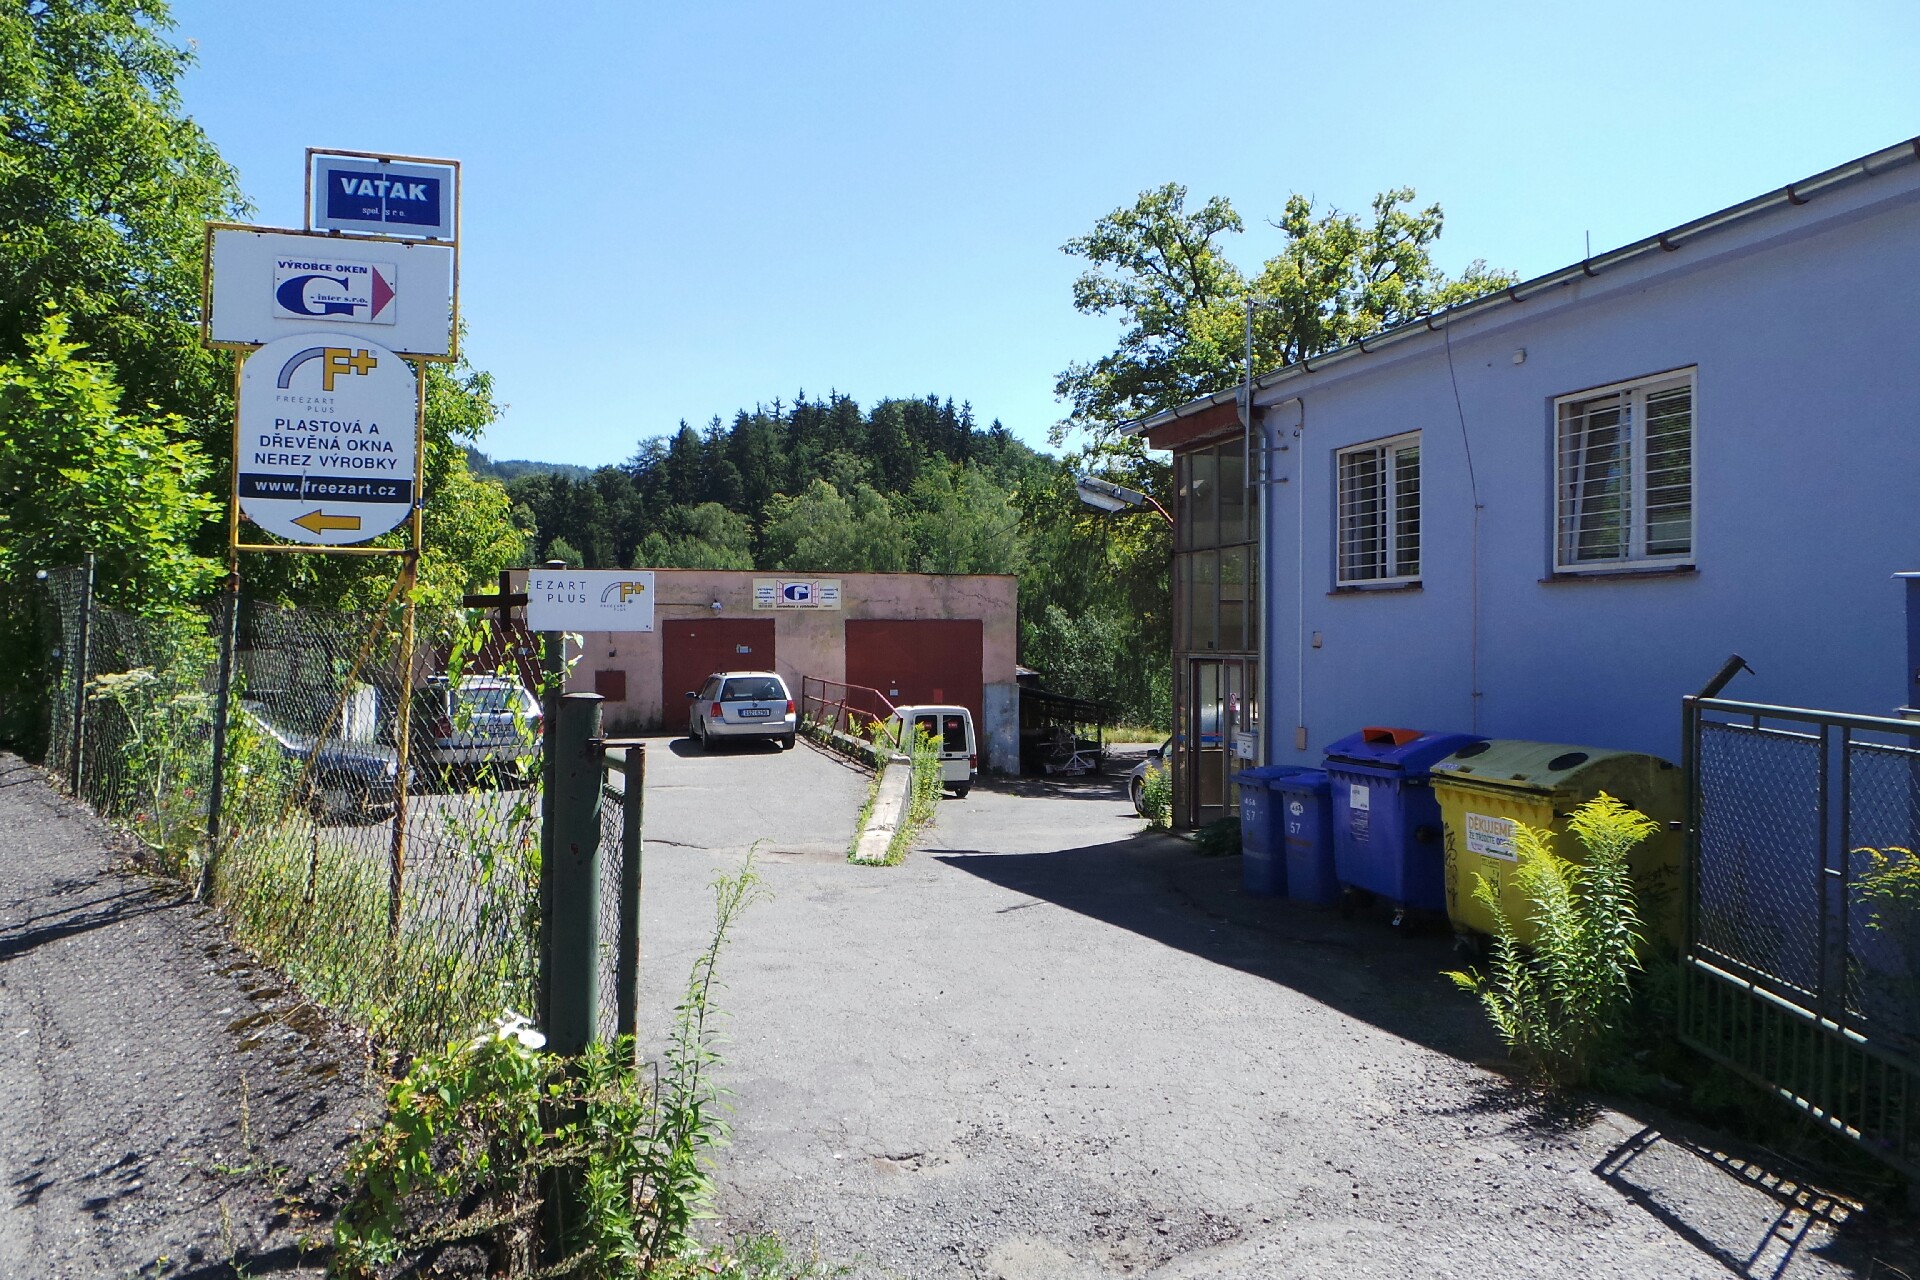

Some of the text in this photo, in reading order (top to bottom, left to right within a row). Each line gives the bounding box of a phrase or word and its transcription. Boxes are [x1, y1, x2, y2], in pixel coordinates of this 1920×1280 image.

[340, 177, 428, 202] VATAK
[278, 259, 368, 274] VÝROBCE OKEN
[276, 395, 335, 405] FREEZART
[307, 405, 335, 414] PLUS
[275, 418, 380, 435] PLASTOVÁ A
[260, 433, 394, 453] DŘEVĚNÁ OKNA
[255, 453, 398, 470] NEREZ VÝROBKY
[255, 479, 396, 496] www.freezart.cz
[547, 593, 586, 603] PLUS
[1246, 809, 1256, 821] 57
[1290, 821, 1301, 834] 57
